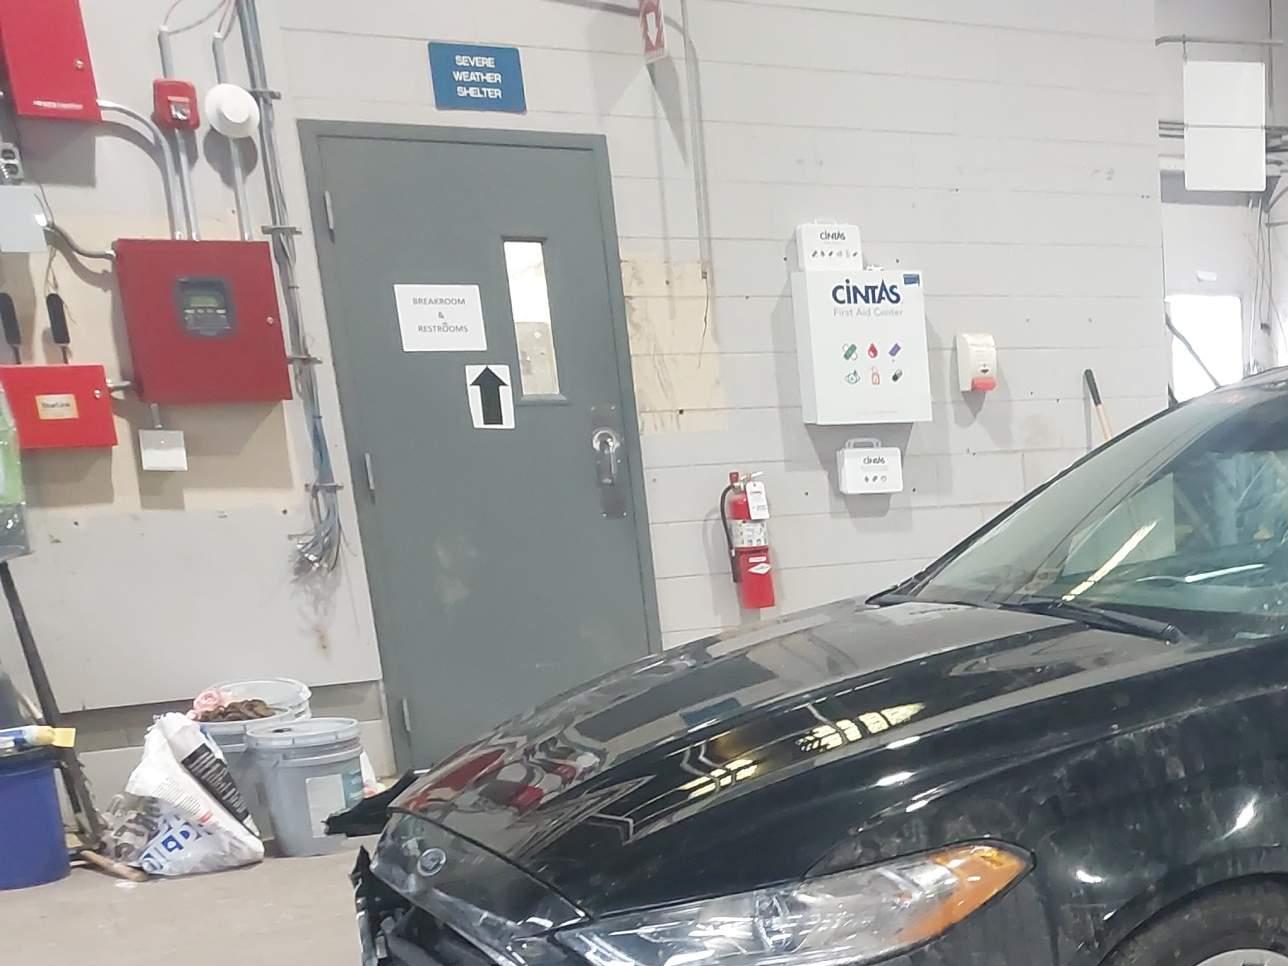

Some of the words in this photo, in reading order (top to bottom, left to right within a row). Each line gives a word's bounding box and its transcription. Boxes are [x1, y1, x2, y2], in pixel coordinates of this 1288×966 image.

[455, 55, 496, 68] SEVERE
[452, 71, 502, 84] WEATHER
[457, 86, 502, 99] SHELTER
[412, 297, 466, 305] BREAKROOM
[834, 307, 853, 317] First
[856, 307, 872, 317] Aid
[874, 307, 904, 317] Center
[417, 324, 469, 333] RESTROOMS
